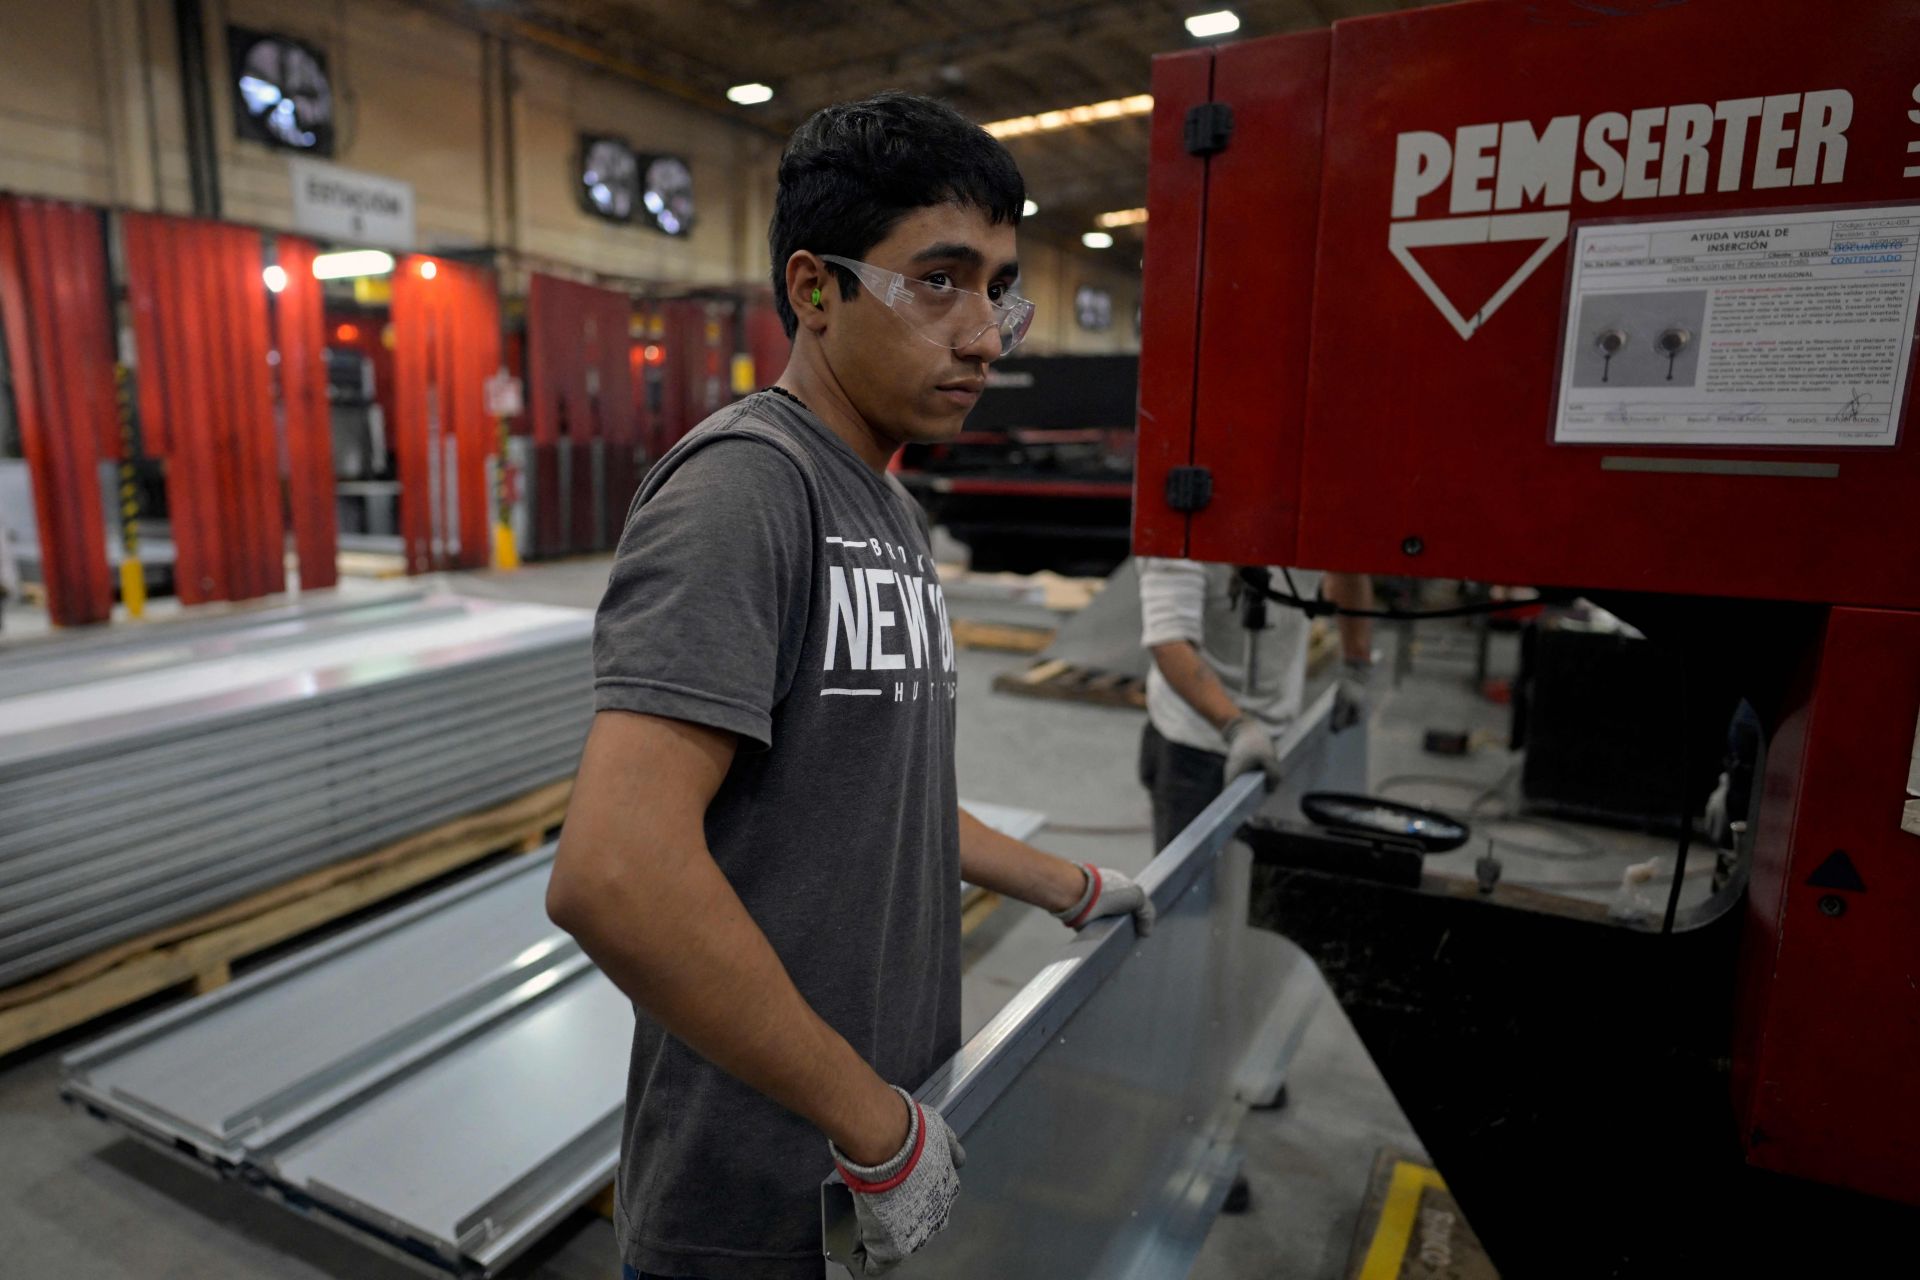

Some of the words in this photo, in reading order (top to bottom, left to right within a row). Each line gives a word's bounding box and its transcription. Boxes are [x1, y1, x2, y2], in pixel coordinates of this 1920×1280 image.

[1391, 89, 1854, 218] PEMSERTER
[1691, 231, 1729, 242] AYUDA
[1733, 229, 1770, 240] VISUAL
[1774, 227, 1789, 238] DE
[1707, 240, 1768, 253] INSERCIÓN
[1834, 241, 1904, 252] DOCUMENTO
[1831, 254, 1903, 265] CONTROLADO
[1702, 274, 1736, 282] AUSENCIA
[1768, 271, 1813, 279] HEXAGONAL
[823, 566, 930, 671] NEW
